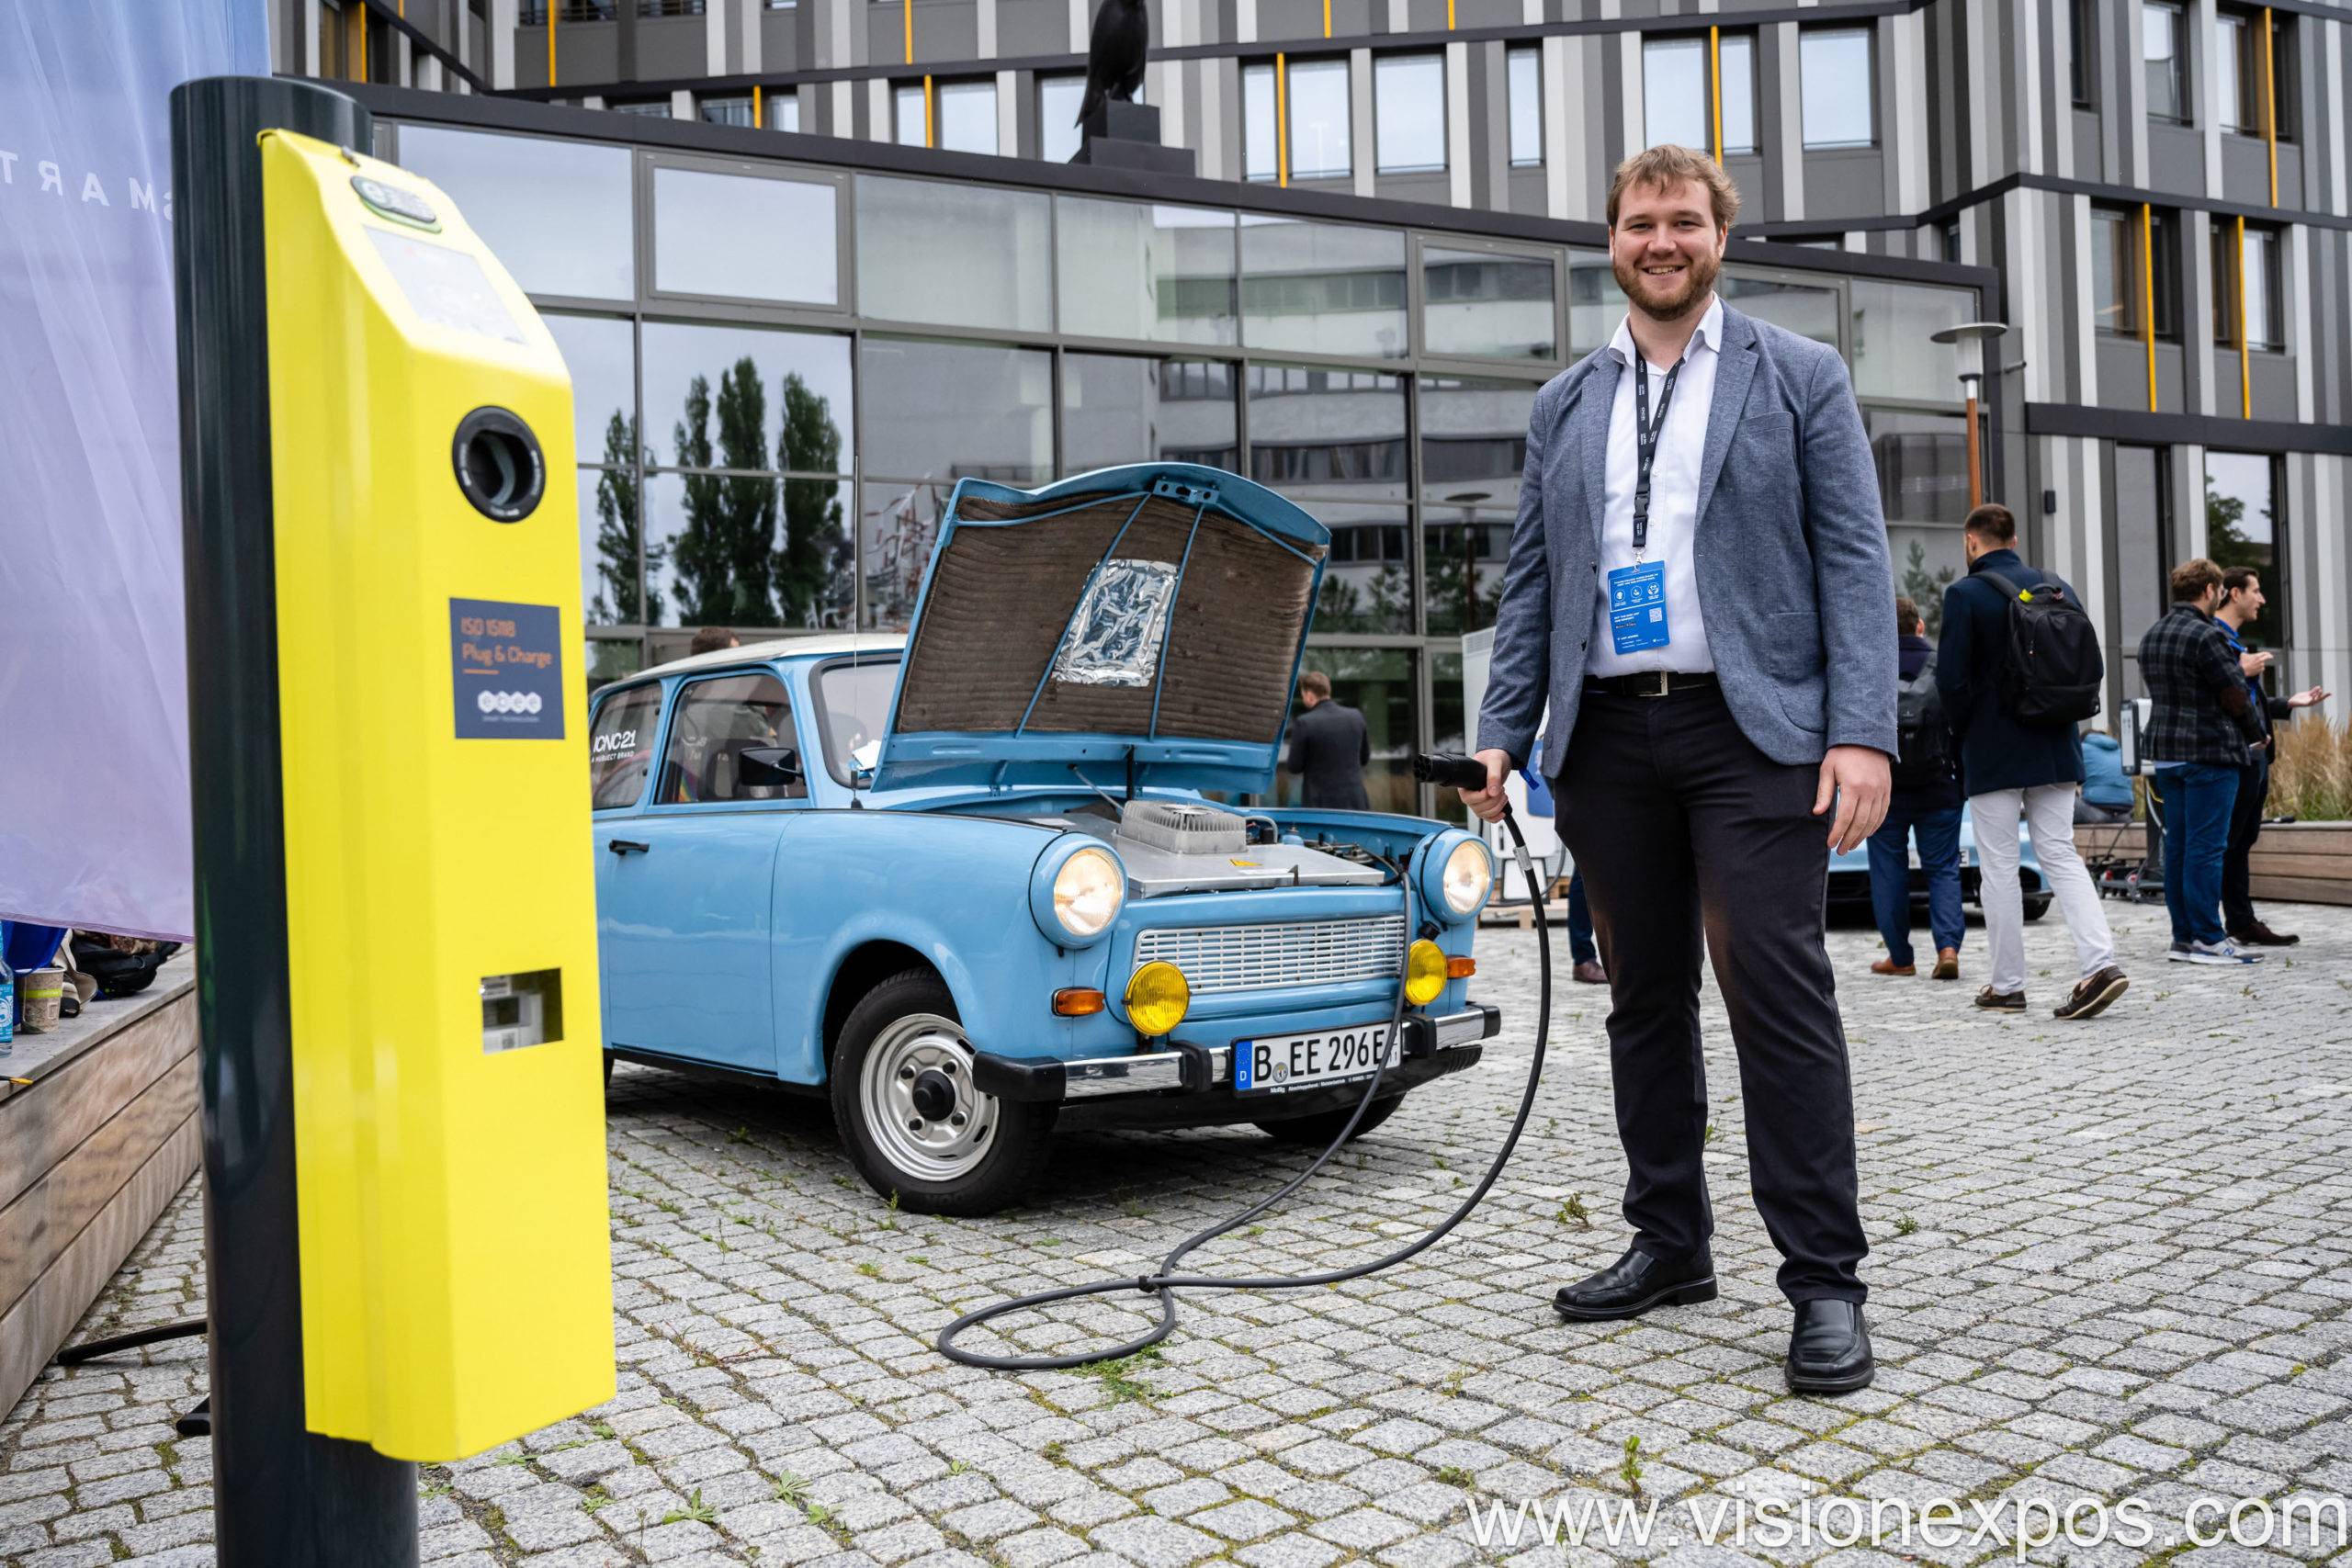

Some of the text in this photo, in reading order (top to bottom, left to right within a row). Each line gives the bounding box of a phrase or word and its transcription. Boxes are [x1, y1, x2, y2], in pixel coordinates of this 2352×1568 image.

[462, 642, 492, 667] Plug
[507, 646, 553, 669] Charge
[593, 729, 637, 753] ICNC21
[1240, 1030, 1385, 1081] D B EE 296E
